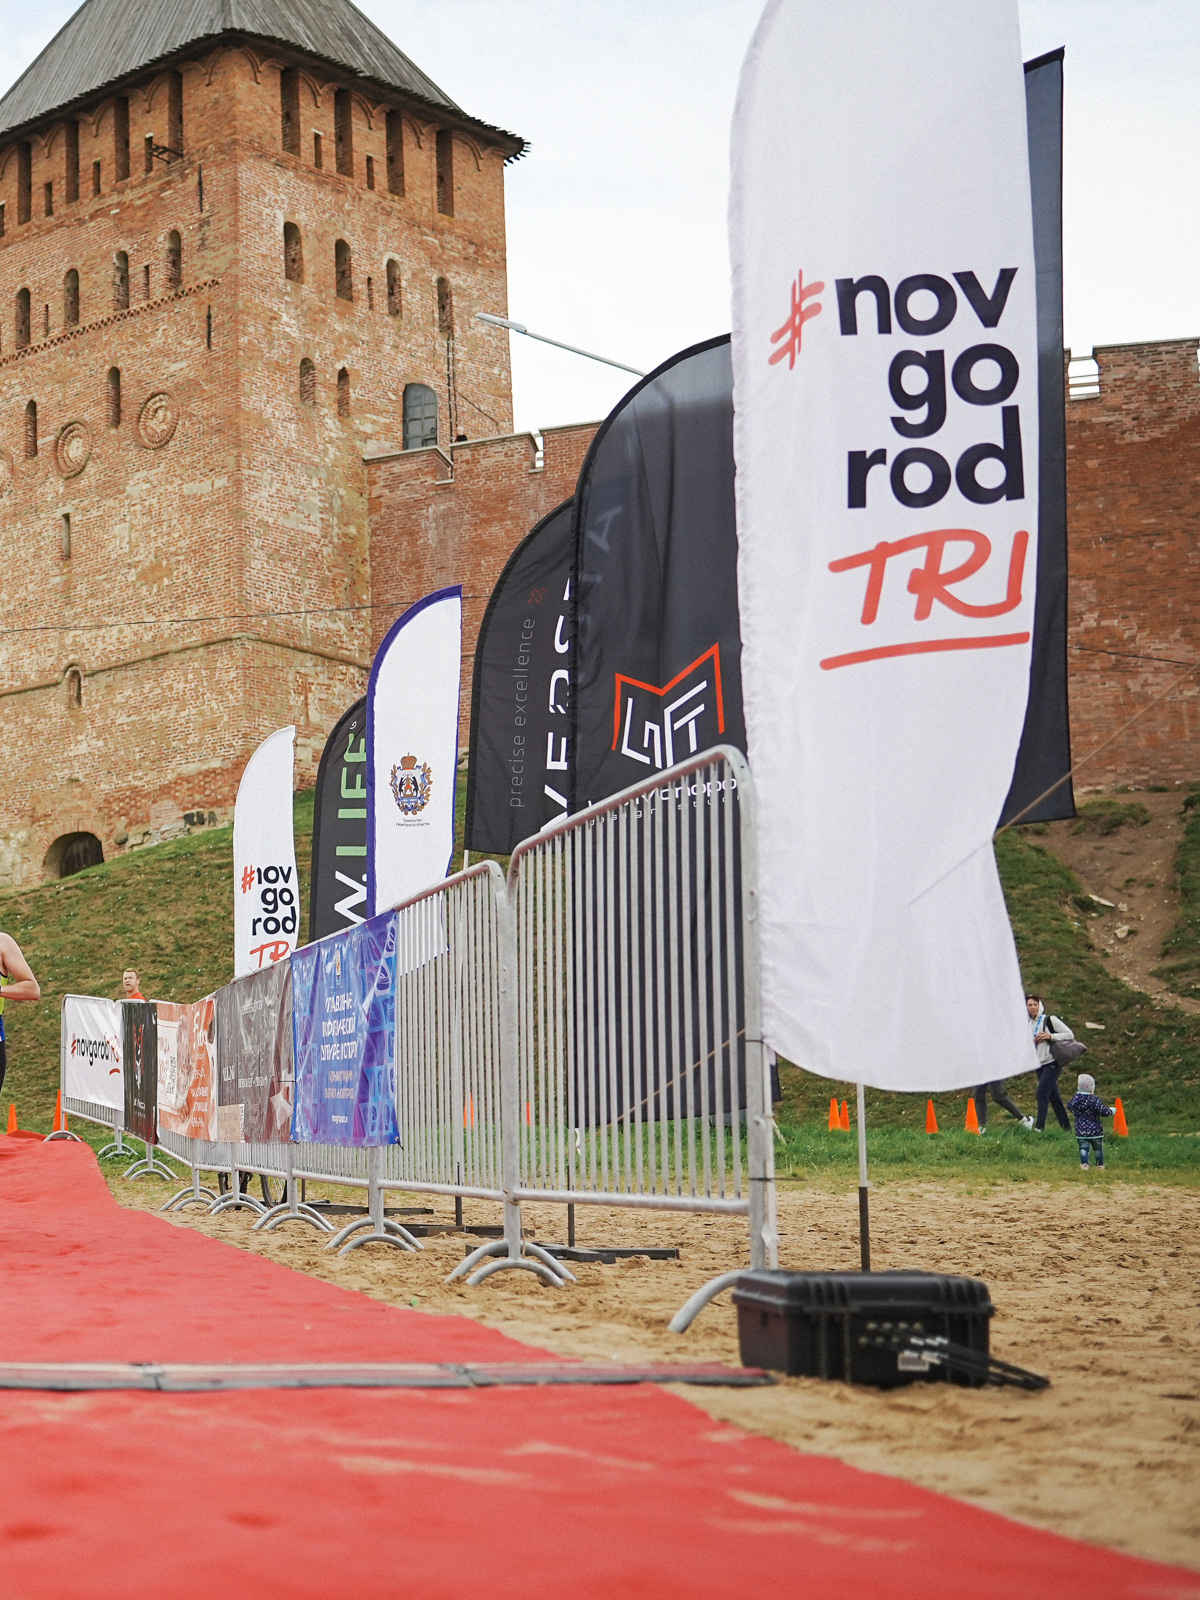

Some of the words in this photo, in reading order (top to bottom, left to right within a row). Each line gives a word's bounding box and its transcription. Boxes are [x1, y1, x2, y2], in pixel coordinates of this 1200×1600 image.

[767, 266, 1019, 371] #nov
[888, 343, 1020, 438] go
[847, 405, 1025, 509] rod
[828, 528, 1029, 625] TRI
[513, 618, 535, 726] excellence
[509, 735, 526, 808] precise
[252, 905, 297, 936] rod
[260, 887, 294, 914] go
